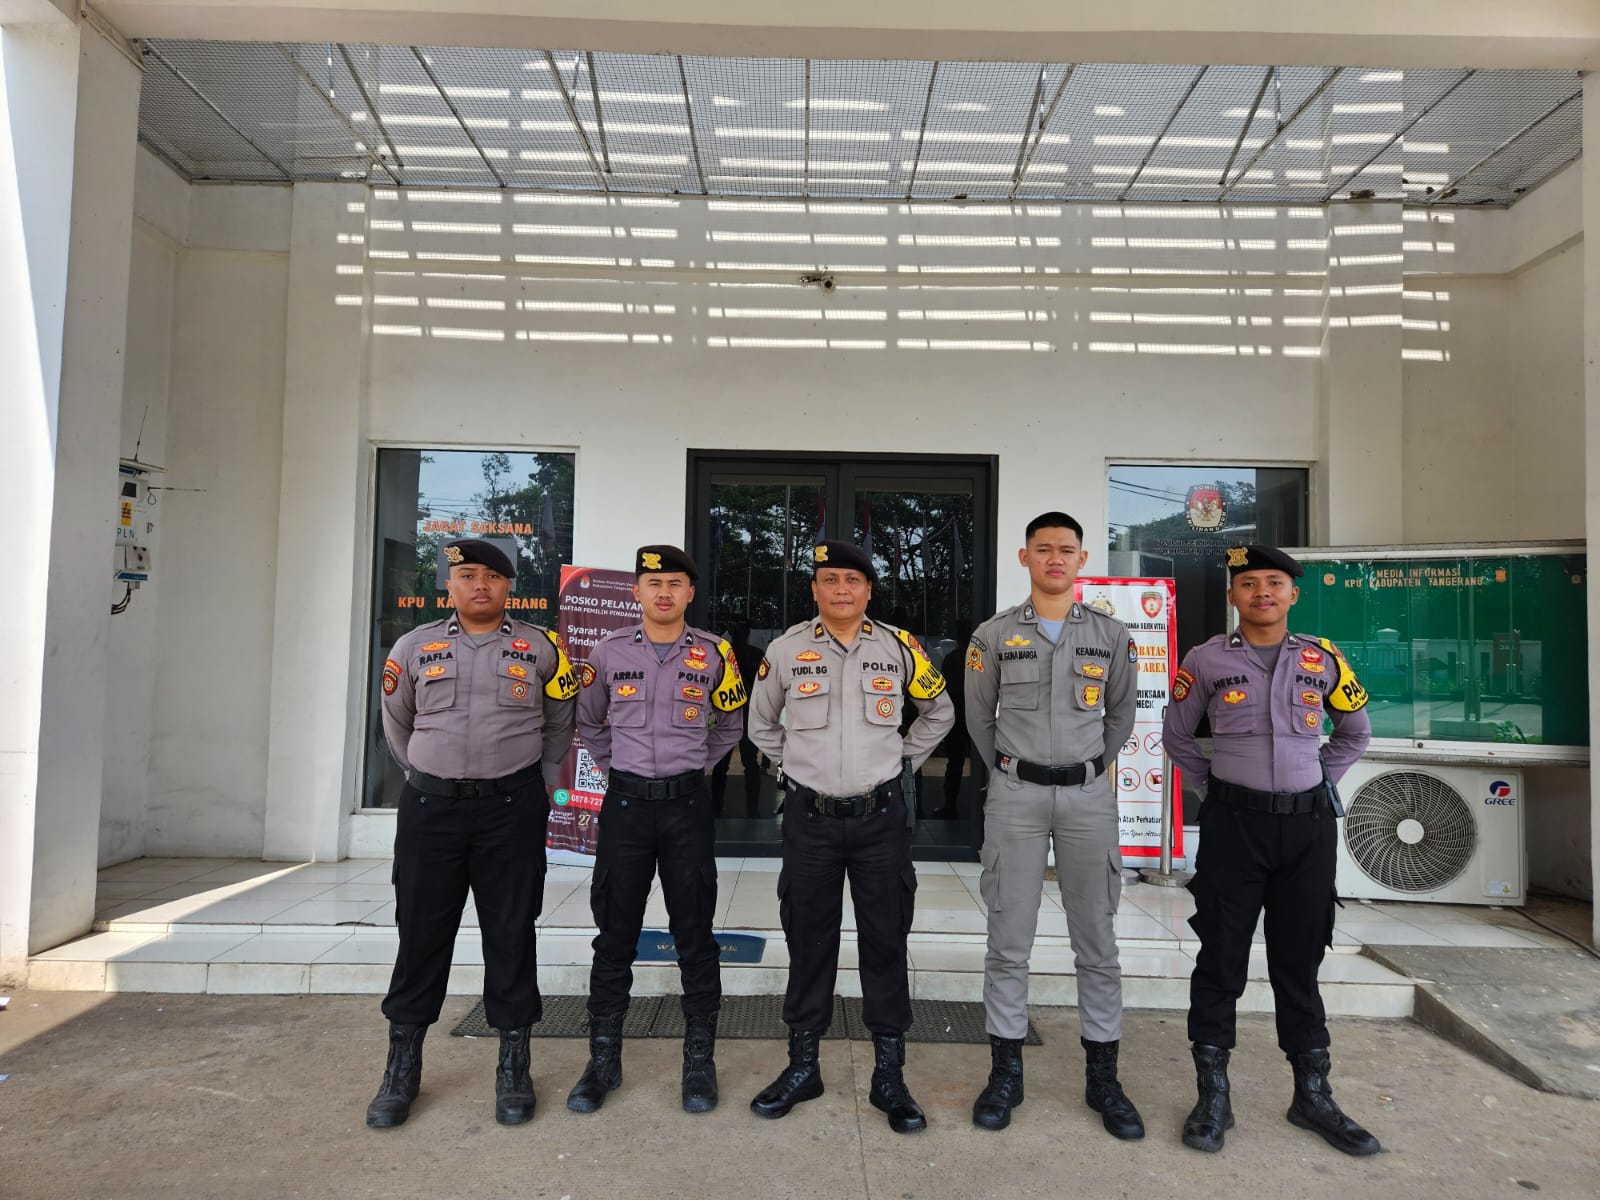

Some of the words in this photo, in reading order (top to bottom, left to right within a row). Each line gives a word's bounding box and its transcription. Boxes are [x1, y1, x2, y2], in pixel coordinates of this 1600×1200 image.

[117, 527, 135, 539] PLN
[423, 520, 467, 533] JAGAT
[471, 522, 533, 535] SAKSANA
[1376, 569, 1404, 578] MEDIA
[1409, 567, 1461, 578] INFORMASI
[1344, 578, 1362, 588] KPU
[1369, 577, 1421, 589] KABUPATEN
[1428, 577, 1483, 587] TANGERANG
[398, 597, 425, 608] KPU
[437, 597, 456, 609] KA
[504, 597, 548, 610] ERANG
[565, 595, 598, 607] POSKO
[601, 599, 643, 611] PELAYAN
[560, 604, 582, 612] DAFTAR
[583, 607, 608, 615] PEMILIH
[609, 609, 641, 618] PINDAHAN
[567, 624, 598, 636] Syarat
[502, 650, 537, 665] POLRI
[1075, 647, 1111, 660] KEAMANAN
[791, 666, 814, 677] YUDI.
[862, 661, 899, 674] POLRI
[1143, 662, 1167, 673] AREA
[613, 671, 644, 681] ARRAS
[678, 671, 709, 685] POLRI
[1213, 674, 1249, 690] HEKSA
[1295, 674, 1328, 691] POLRI
[1137, 689, 1166, 699] RIKSAAN
[1484, 797, 1517, 806] GREE
[577, 813, 592, 827] 27
[1122, 815, 1135, 823] Atas
